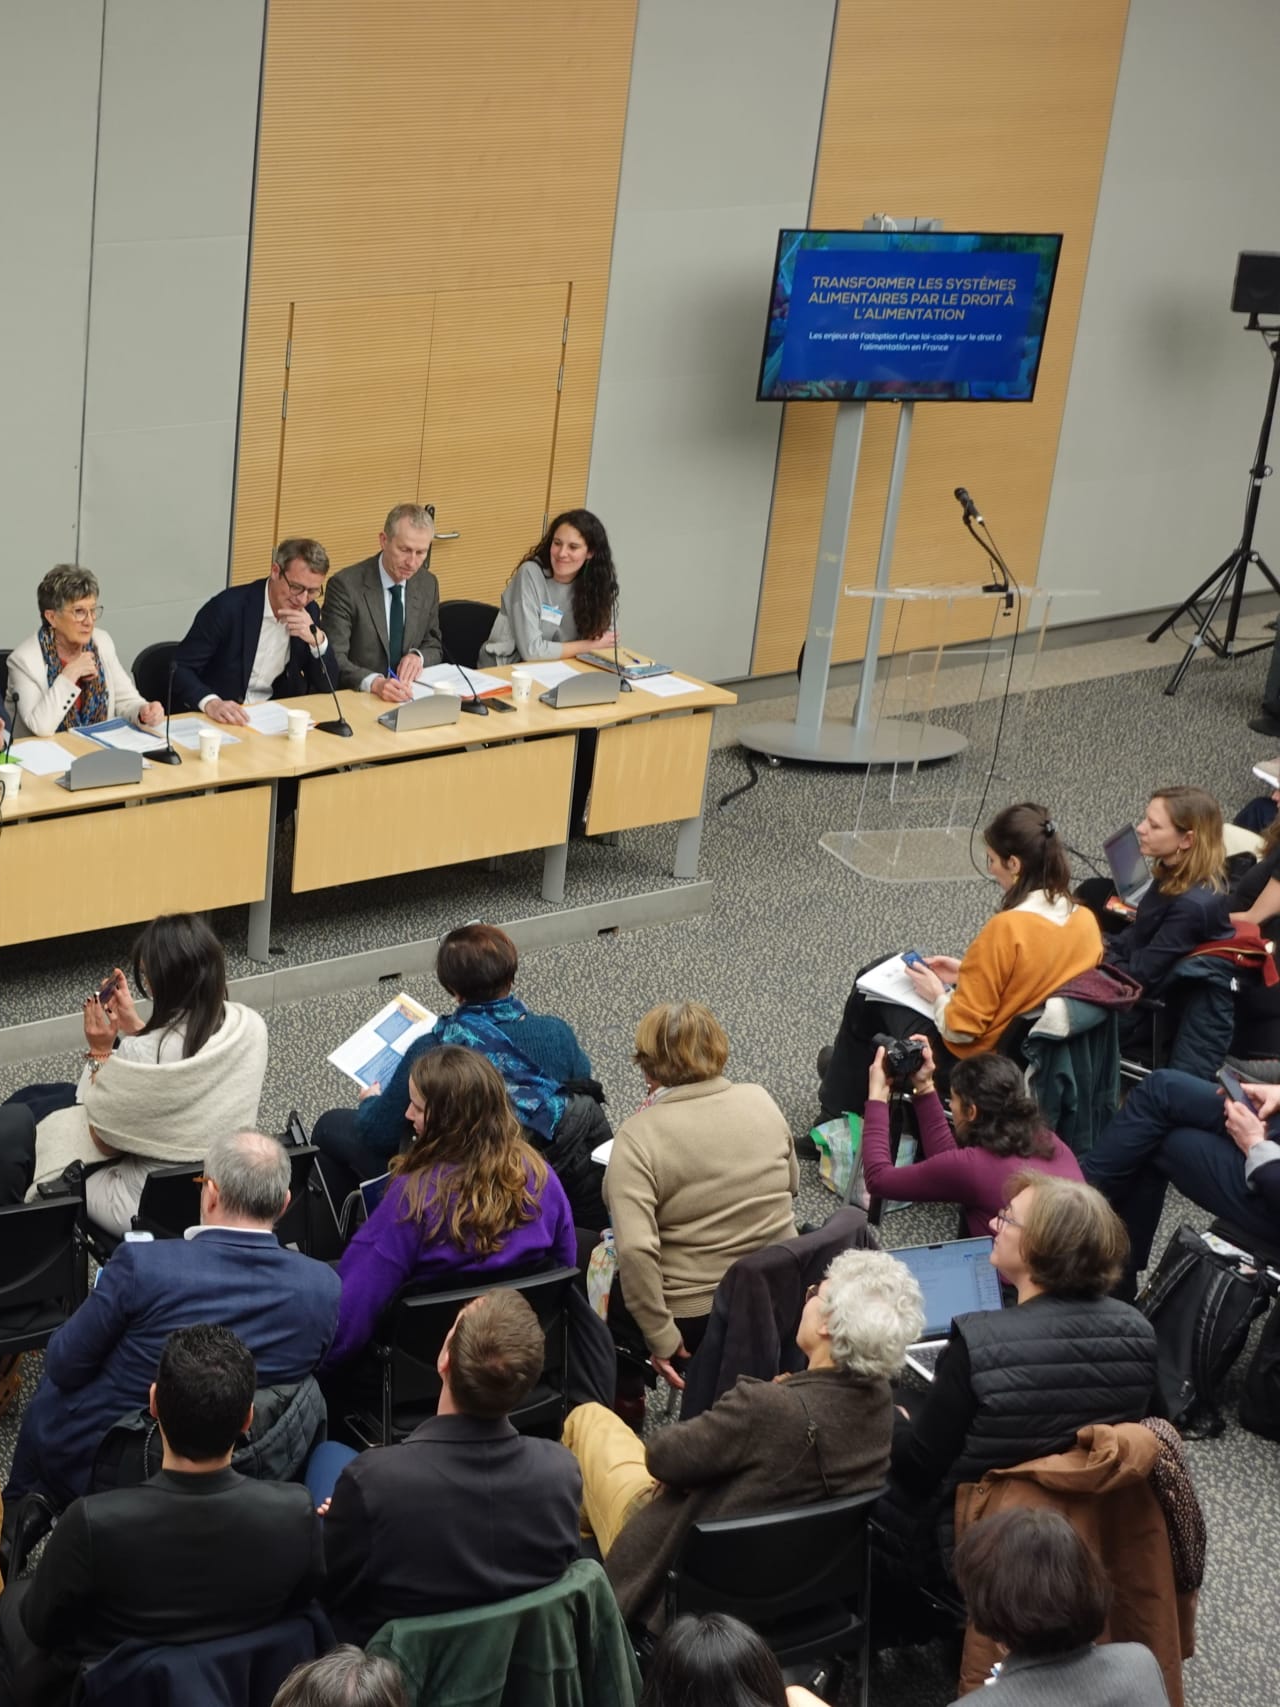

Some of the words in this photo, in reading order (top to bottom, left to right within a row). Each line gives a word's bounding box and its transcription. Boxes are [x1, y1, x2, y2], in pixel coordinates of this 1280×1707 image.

[812, 276, 915, 289] TRANSFORMER
[918, 277, 943, 290] LES
[946, 275, 1017, 291] SYSTÈMES
[808, 291, 908, 304] ALIMENTAIRES
[910, 293, 939, 305] PAR
[942, 293, 958, 305] LE
[961, 294, 1002, 306] DROIT
[1003, 291, 1014, 306] À
[854, 307, 965, 320] L'ALIMENTATION
[809, 331, 823, 340] Les
[824, 332, 848, 342] enjeux
[849, 332, 860, 340] de
[969, 333, 976, 341] le
[977, 333, 995, 341] droit
[922, 343, 949, 351] France
